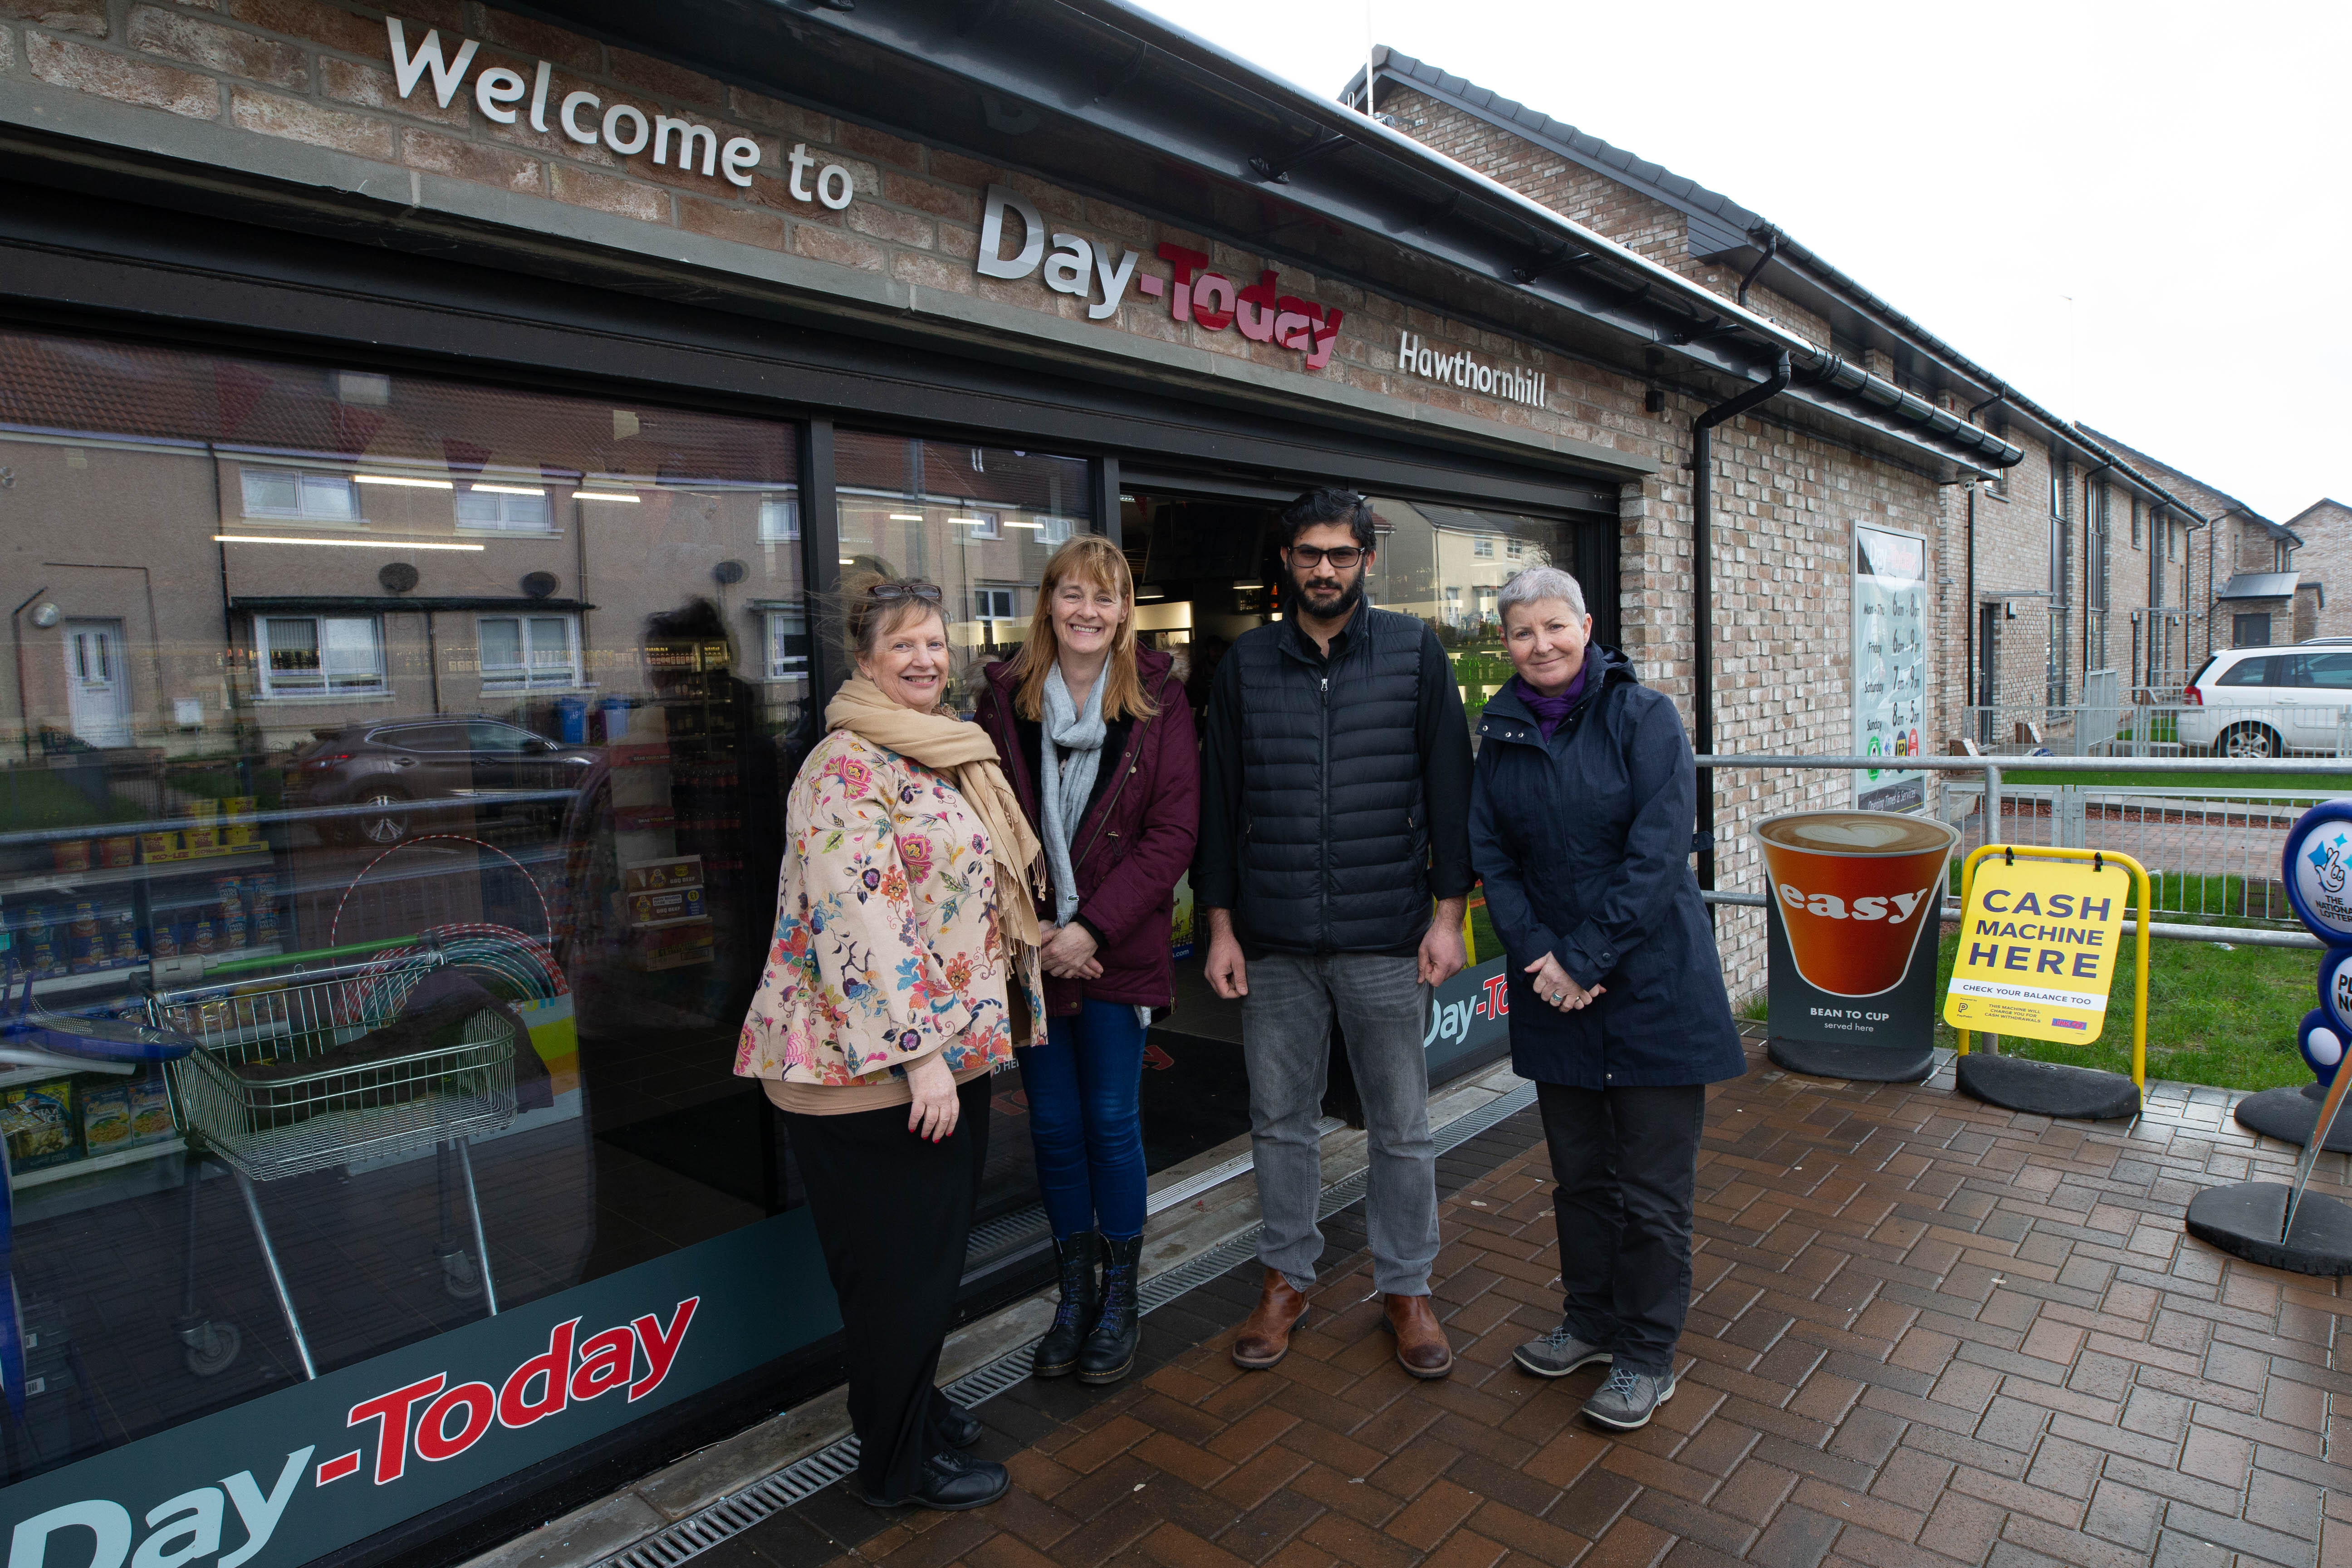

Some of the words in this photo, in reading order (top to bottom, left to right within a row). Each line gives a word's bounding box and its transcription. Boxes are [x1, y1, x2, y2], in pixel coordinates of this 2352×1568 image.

[386, 16, 761, 187] Welcome
[788, 142, 853, 210] to
[977, 182, 1345, 371] Day-Today
[1399, 330, 1546, 407] Hawthornhill
[1863, 603, 1873, 615] Mon
[1868, 642, 1882, 656] Friday
[1864, 681, 1884, 695] Saturday
[1867, 718, 1882, 732] Sunday
[1885, 794, 1896, 807] Times
[1901, 788, 1916, 802] Services
[1779, 884, 1928, 924] easy
[1983, 889, 2111, 921] CASH
[2325, 895, 2344, 905] THE
[1975, 920, 2105, 946] MACHINE
[1968, 942, 2100, 979] HERE
[1963, 984, 1993, 993] CHECK
[1996, 988, 2021, 997] YOUR
[2024, 992, 2067, 1002] BALANCE
[1810, 1007, 1842, 1018] BEAN
[1846, 1010, 1862, 1019] TO
[1866, 1012, 1889, 1021] CUP
[2000, 1014, 2041, 1023] WITHDRAWALS
[1855, 1023, 1874, 1032] here
[2, 1295, 701, 1568] Day-Today
